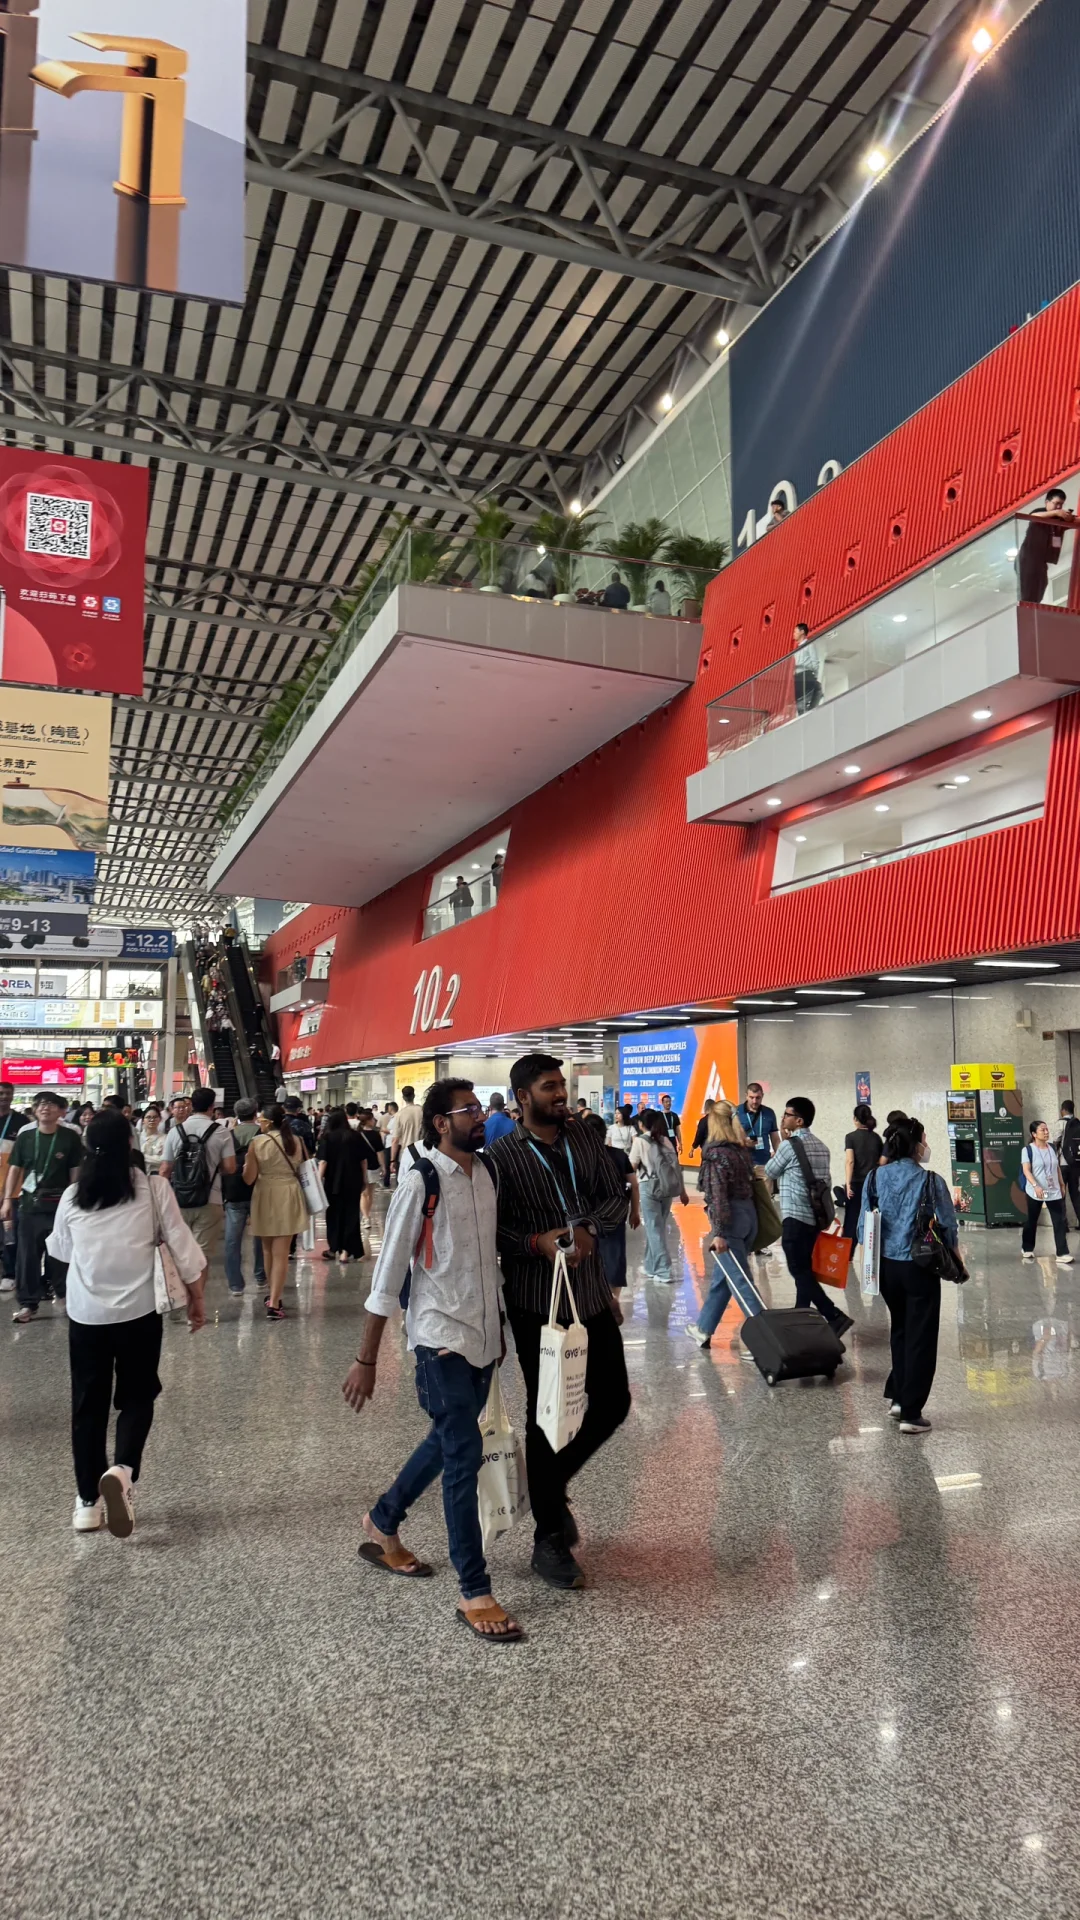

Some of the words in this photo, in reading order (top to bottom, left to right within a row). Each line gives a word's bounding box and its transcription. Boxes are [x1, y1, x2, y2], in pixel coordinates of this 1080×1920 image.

[11, 917, 51, 933] 9-13
[136, 934, 169, 948] 12.2
[409, 964, 461, 1036] 10.2
